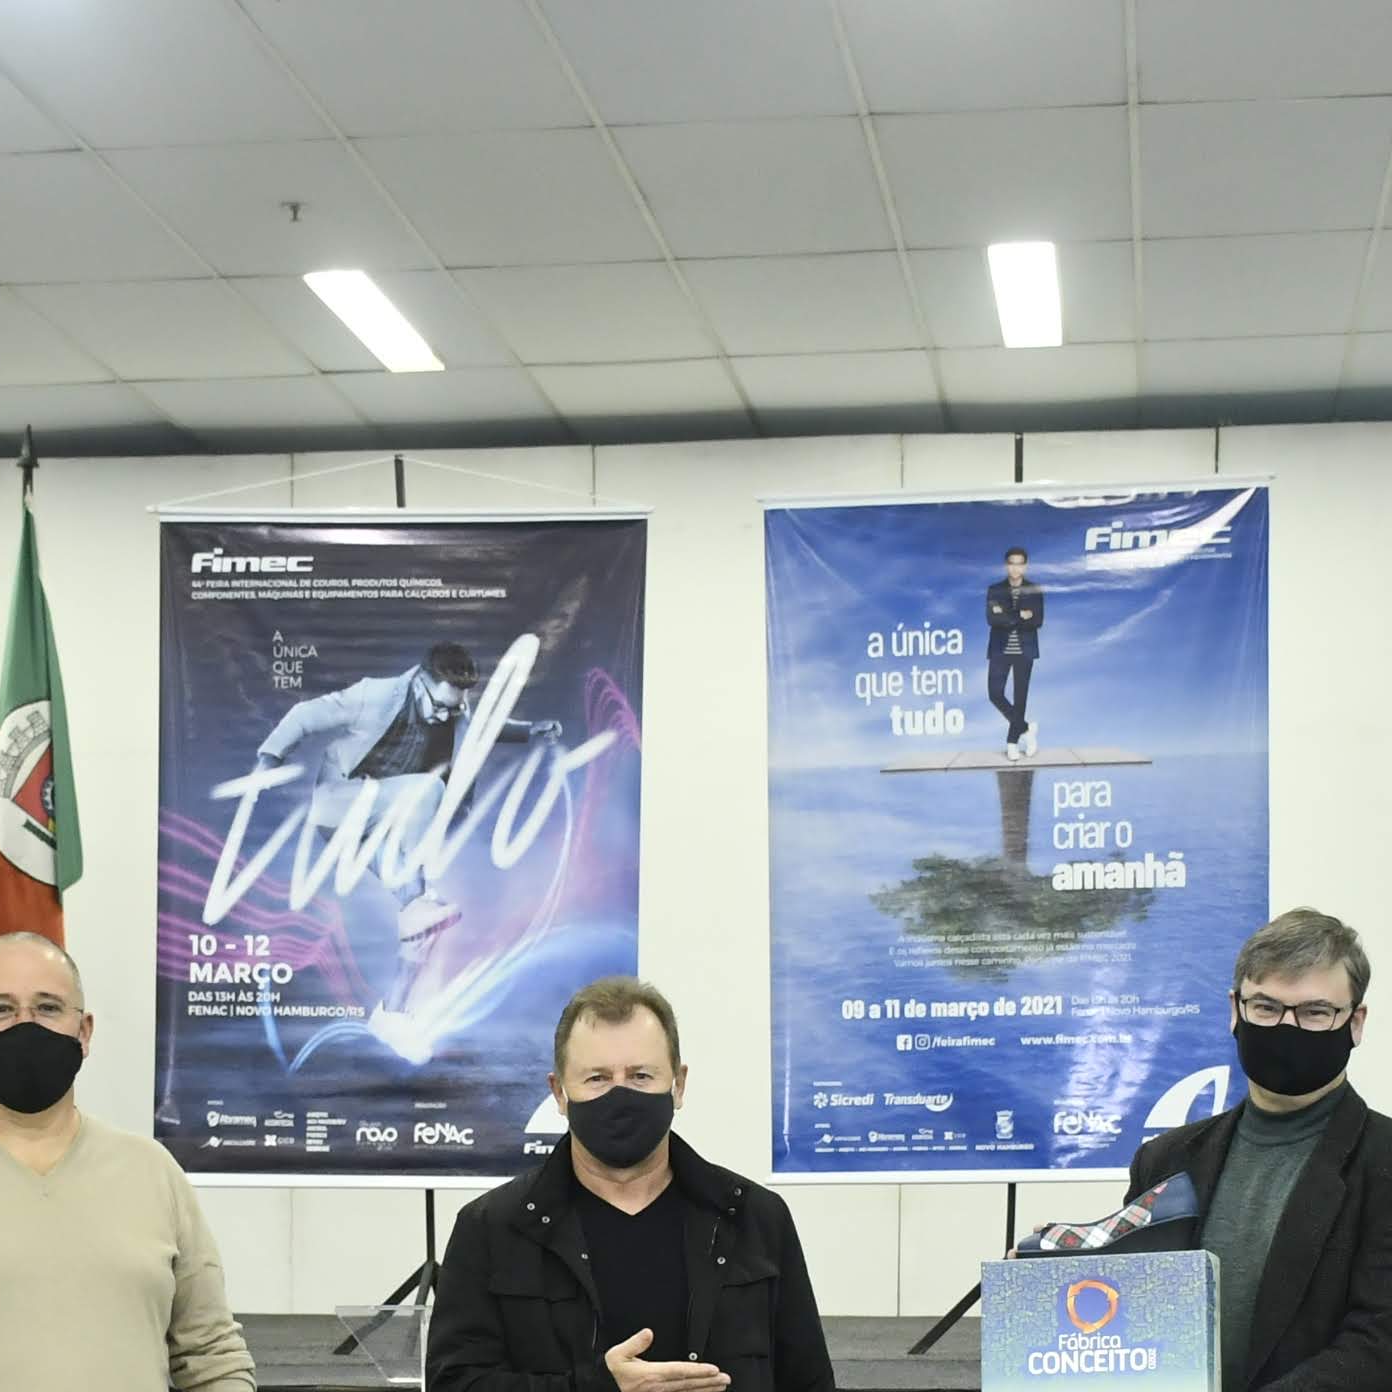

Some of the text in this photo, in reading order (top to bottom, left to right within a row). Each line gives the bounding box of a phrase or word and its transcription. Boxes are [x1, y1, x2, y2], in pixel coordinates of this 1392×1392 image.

[231, 579, 298, 588] INTERNACIONAL
[300, 578, 311, 587] DE
[312, 589, 378, 599] EQUIPAMENTOS
[380, 589, 403, 598] PARA
[404, 588, 450, 600] CALÇADOS
[452, 589, 458, 598] E
[272, 630, 284, 642] A
[867, 621, 963, 658] a única
[272, 643, 318, 658] ÚNICA
[272, 661, 303, 675] QUE
[272, 675, 302, 689] TEM
[854, 665, 963, 706] que tem
[889, 701, 964, 736] tudo
[1053, 780, 1112, 818] para
[1053, 812, 1133, 849] criar o
[1052, 851, 1186, 891] amanhã
[188, 934, 217, 956] 10
[244, 934, 270, 956] 12
[189, 962, 293, 990] MARÇO
[188, 991, 213, 1002] DAS
[215, 991, 235, 1002] 13H
[188, 1005, 228, 1017] FENAC
[235, 1005, 272, 1016] NOVO
[274, 1005, 365, 1018] HAMBURGO/RS
[841, 995, 1063, 1021] 09 a 11 de março de 2021
[830, 1093, 875, 1106] Sicredi
[1059, 1332, 1121, 1350] Fábrica
[1028, 1348, 1149, 1375] CONCEITO
